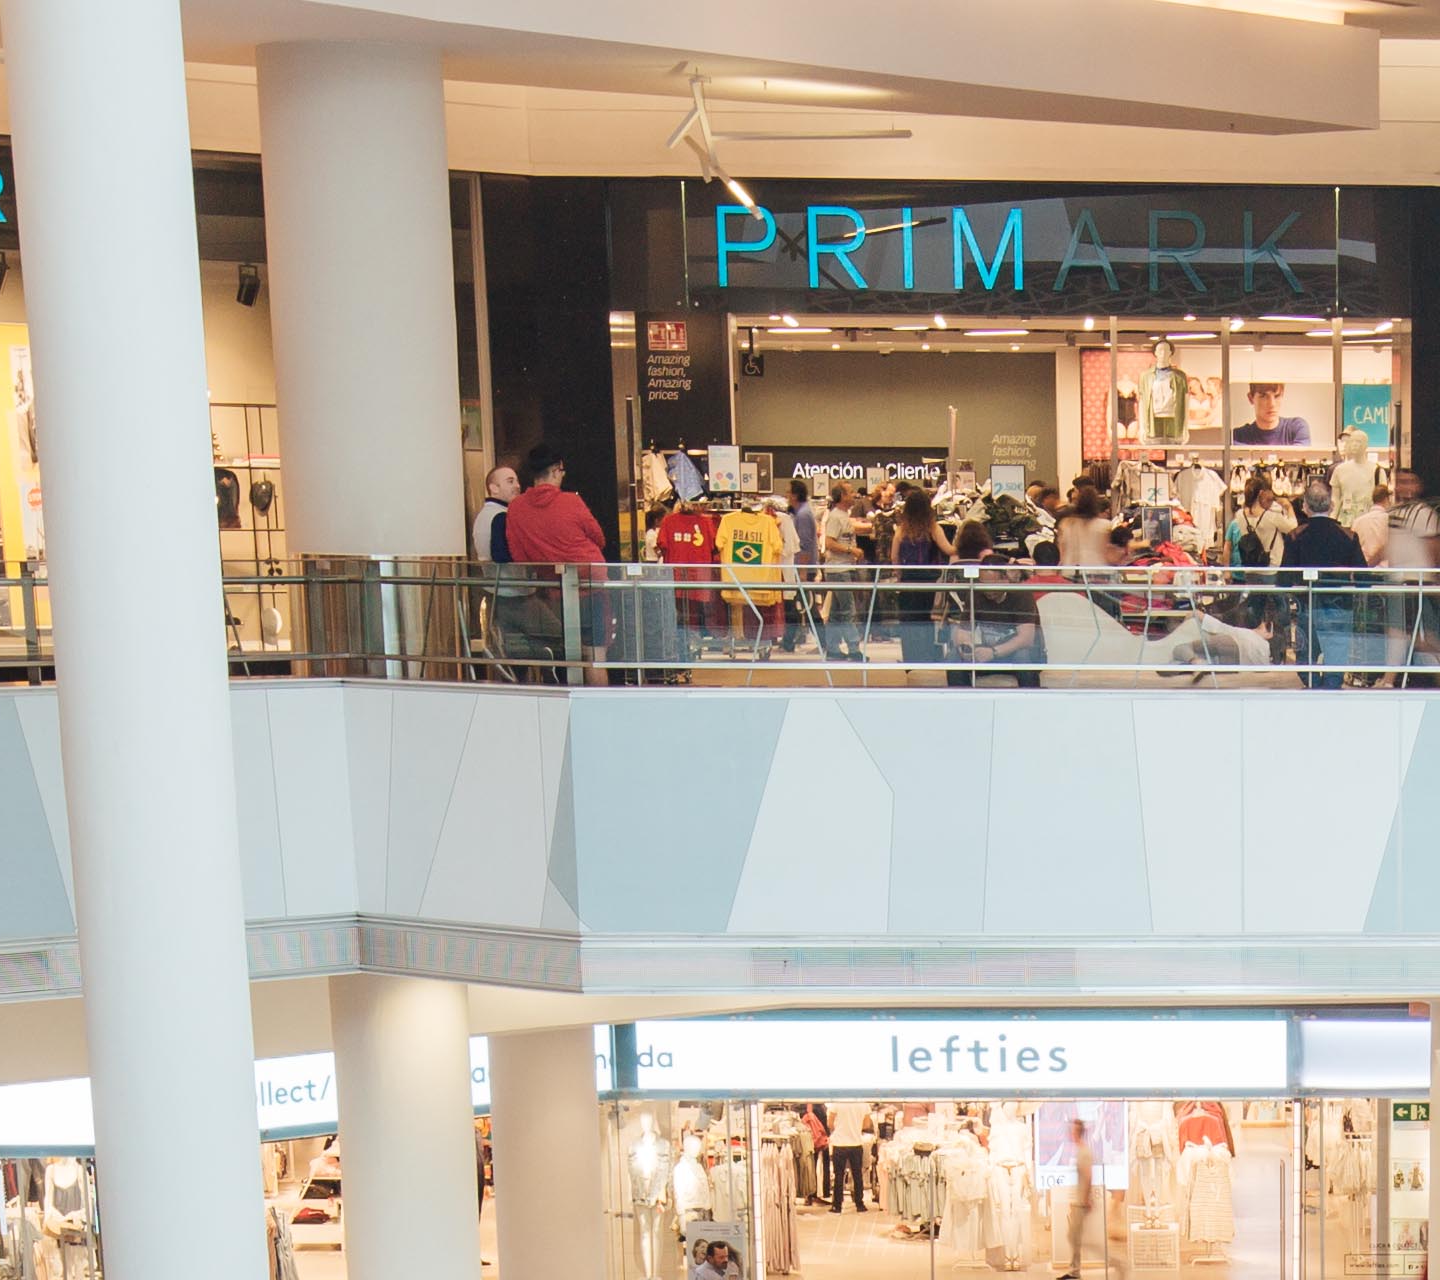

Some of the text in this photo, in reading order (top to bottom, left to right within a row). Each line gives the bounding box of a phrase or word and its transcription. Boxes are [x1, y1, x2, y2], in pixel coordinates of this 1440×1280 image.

[716, 204, 1303, 293] PRIMARK
[647, 354, 691, 367] Amazing
[648, 366, 686, 378] fashion,
[648, 378, 692, 391] Amazing
[648, 390, 679, 401] prices
[992, 434, 1037, 446] Amazing
[993, 445, 1031, 458] fashion,
[792, 462, 864, 480] Atención
[733, 529, 764, 543] BRASIL
[892, 1034, 1069, 1074] lefties
[253, 1076, 331, 1107] llect/
